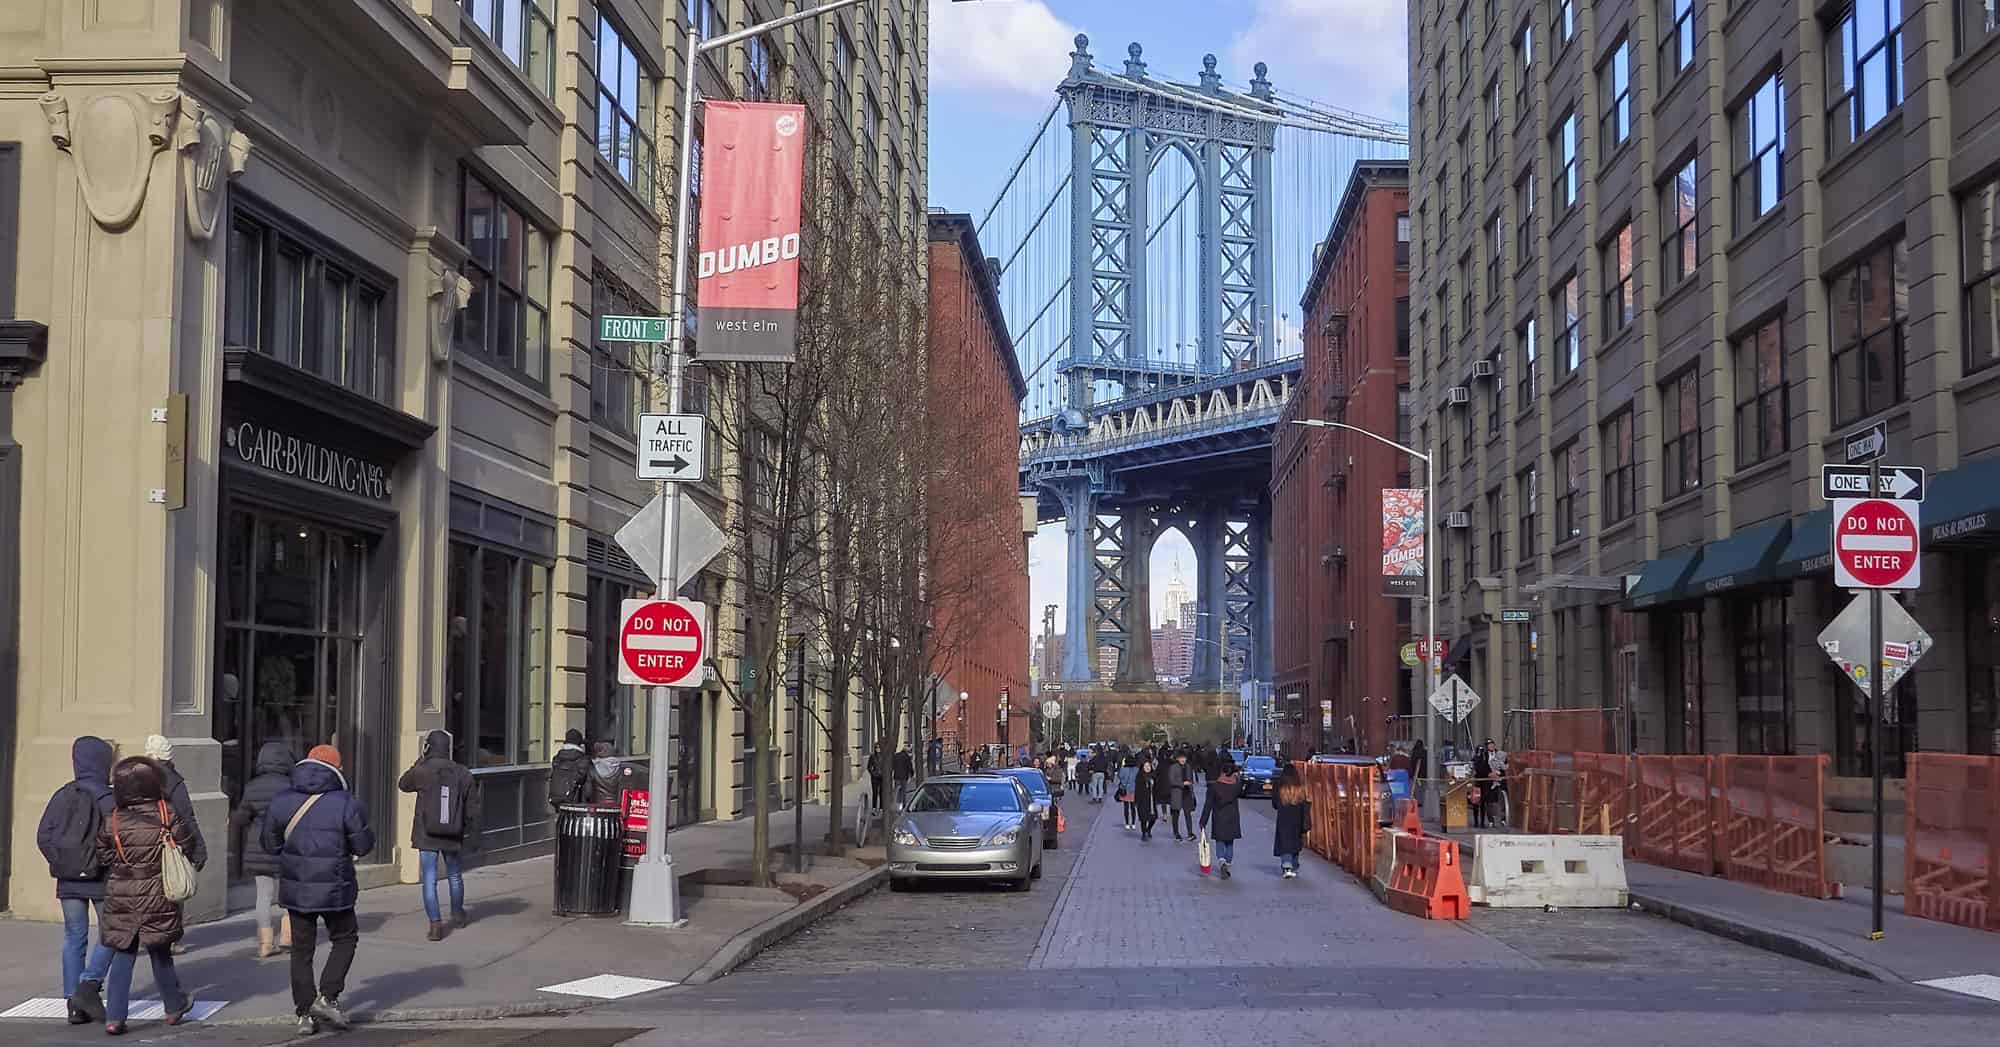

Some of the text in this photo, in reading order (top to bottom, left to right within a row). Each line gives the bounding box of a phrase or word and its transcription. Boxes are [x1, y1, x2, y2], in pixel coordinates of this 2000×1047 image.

[699, 232, 800, 279] DUMBO
[605, 319, 665, 339] FRONT ST
[716, 319, 778, 332] west elm
[656, 419, 687, 436] ALL
[649, 439, 693, 453] TRAFFIC
[1850, 440, 1863, 457] ONE
[1834, 476, 1861, 489] ONE
[1848, 516, 1905, 531] DO NOT
[1383, 546, 1424, 566] DUMBO
[1854, 555, 1900, 569] ENTER
[633, 617, 692, 632] DO NOT
[638, 654, 684, 669] ENTER
